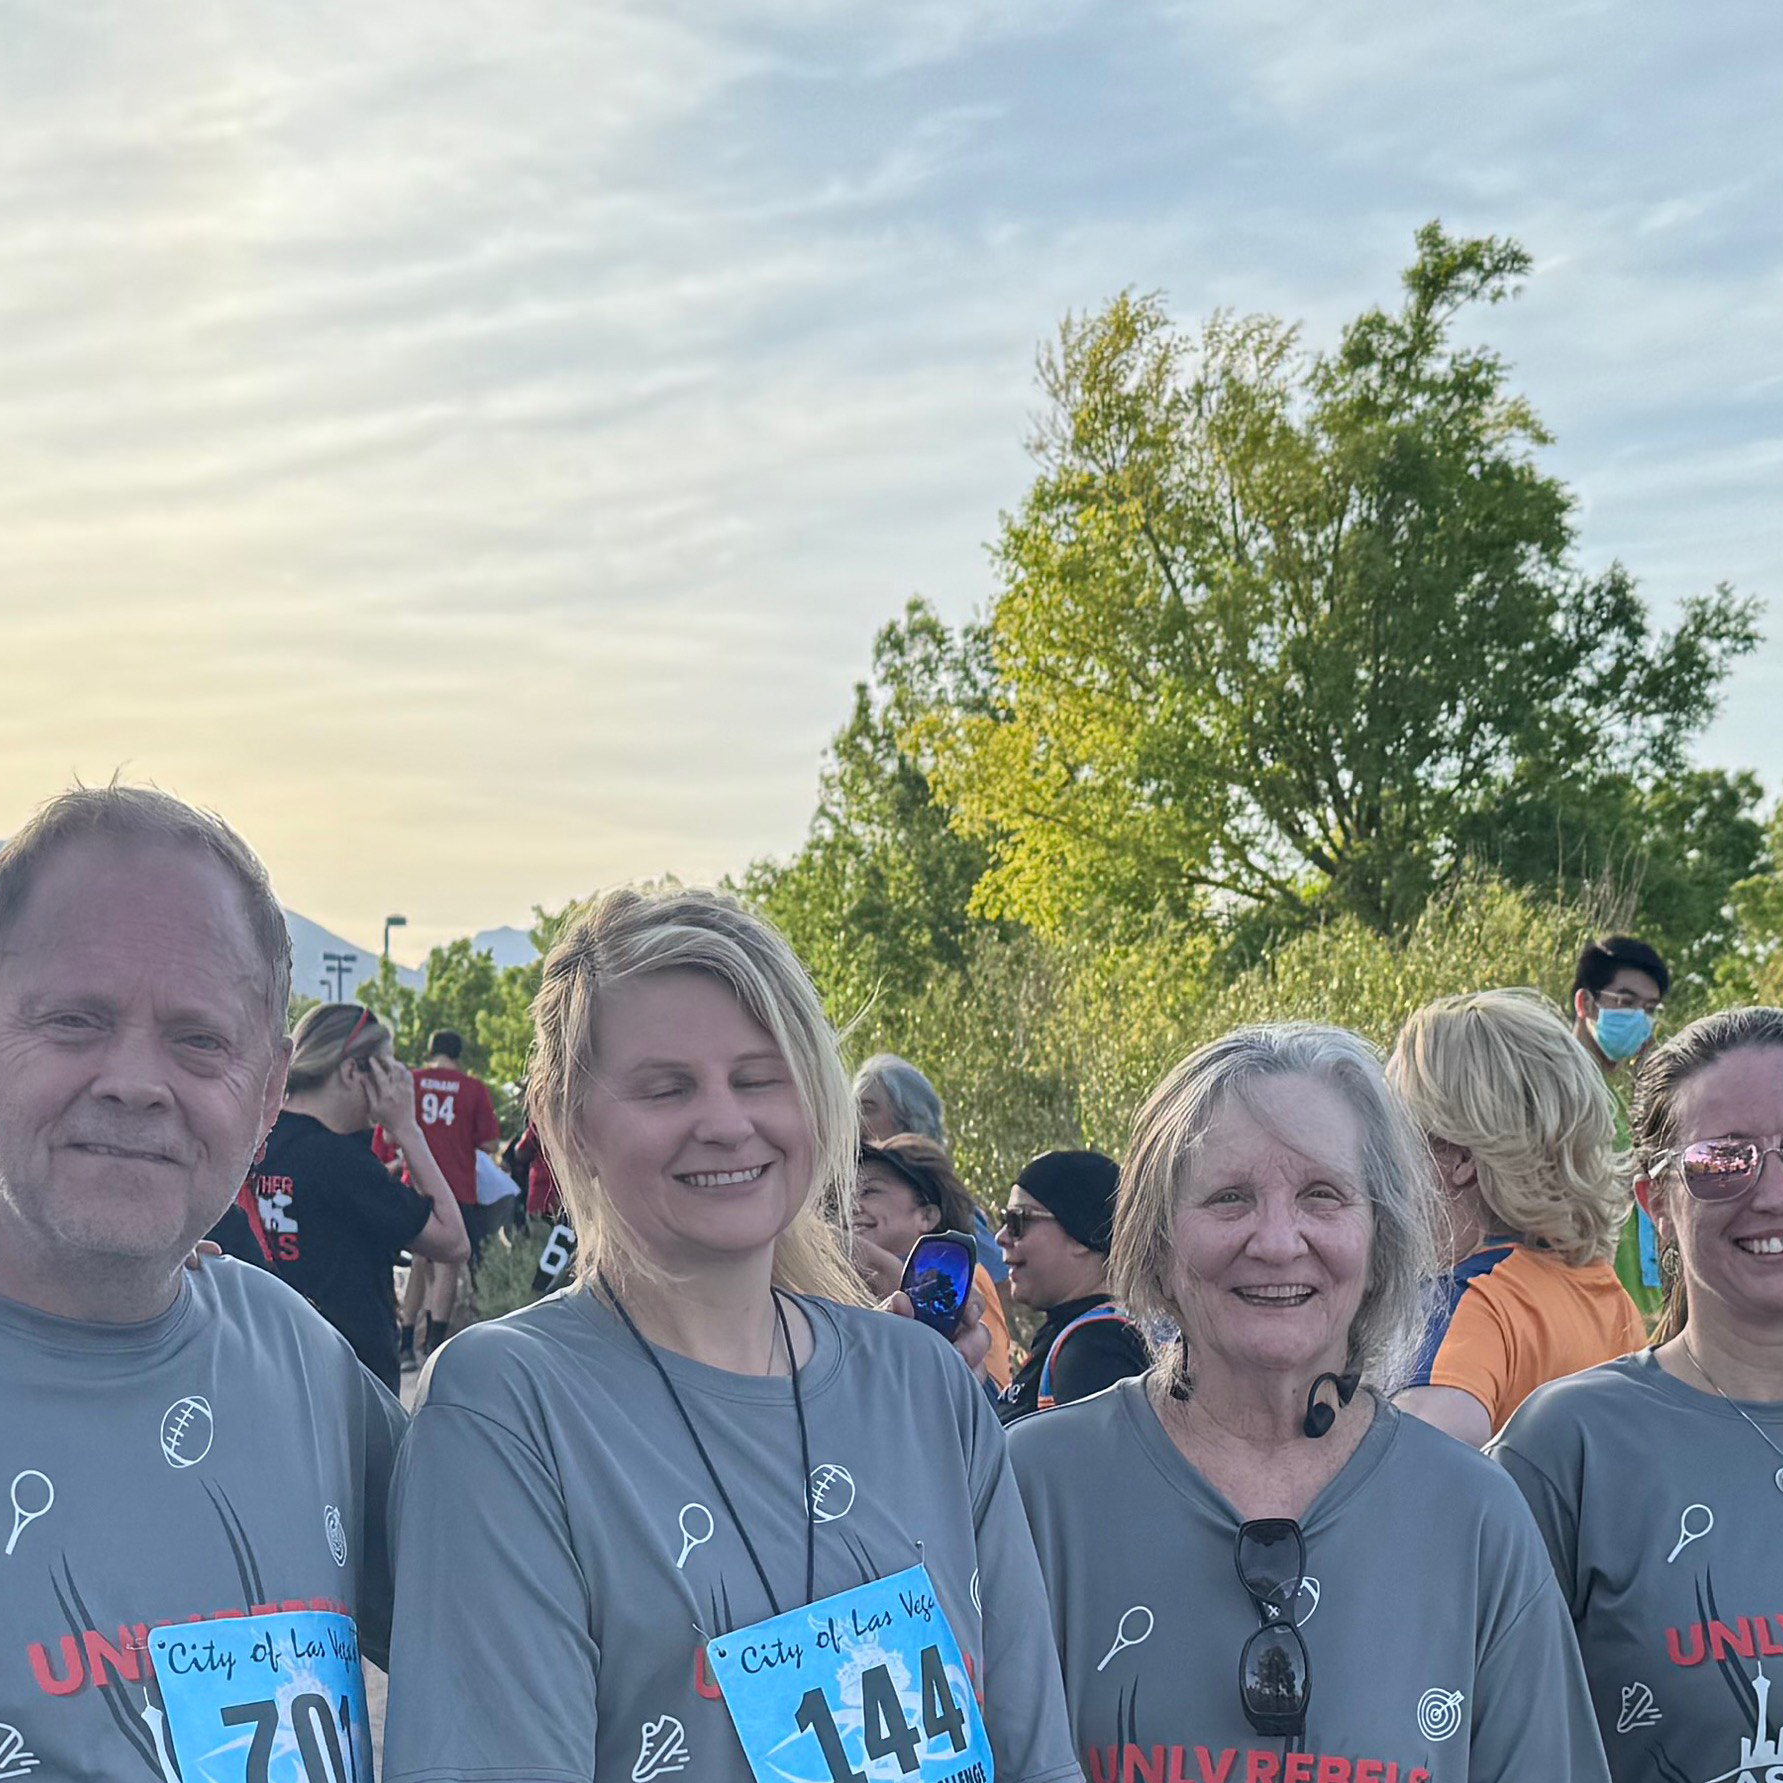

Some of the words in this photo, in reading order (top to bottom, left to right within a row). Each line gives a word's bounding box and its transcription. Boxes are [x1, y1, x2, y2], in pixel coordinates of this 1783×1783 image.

[422, 1093, 455, 1126] 94
[168, 1640, 236, 1681] City
[250, 1631, 281, 1673] of
[291, 1628, 325, 1659] Las
[741, 1637, 804, 1673] City
[816, 1617, 843, 1653] of
[852, 1608, 893, 1635] Las
